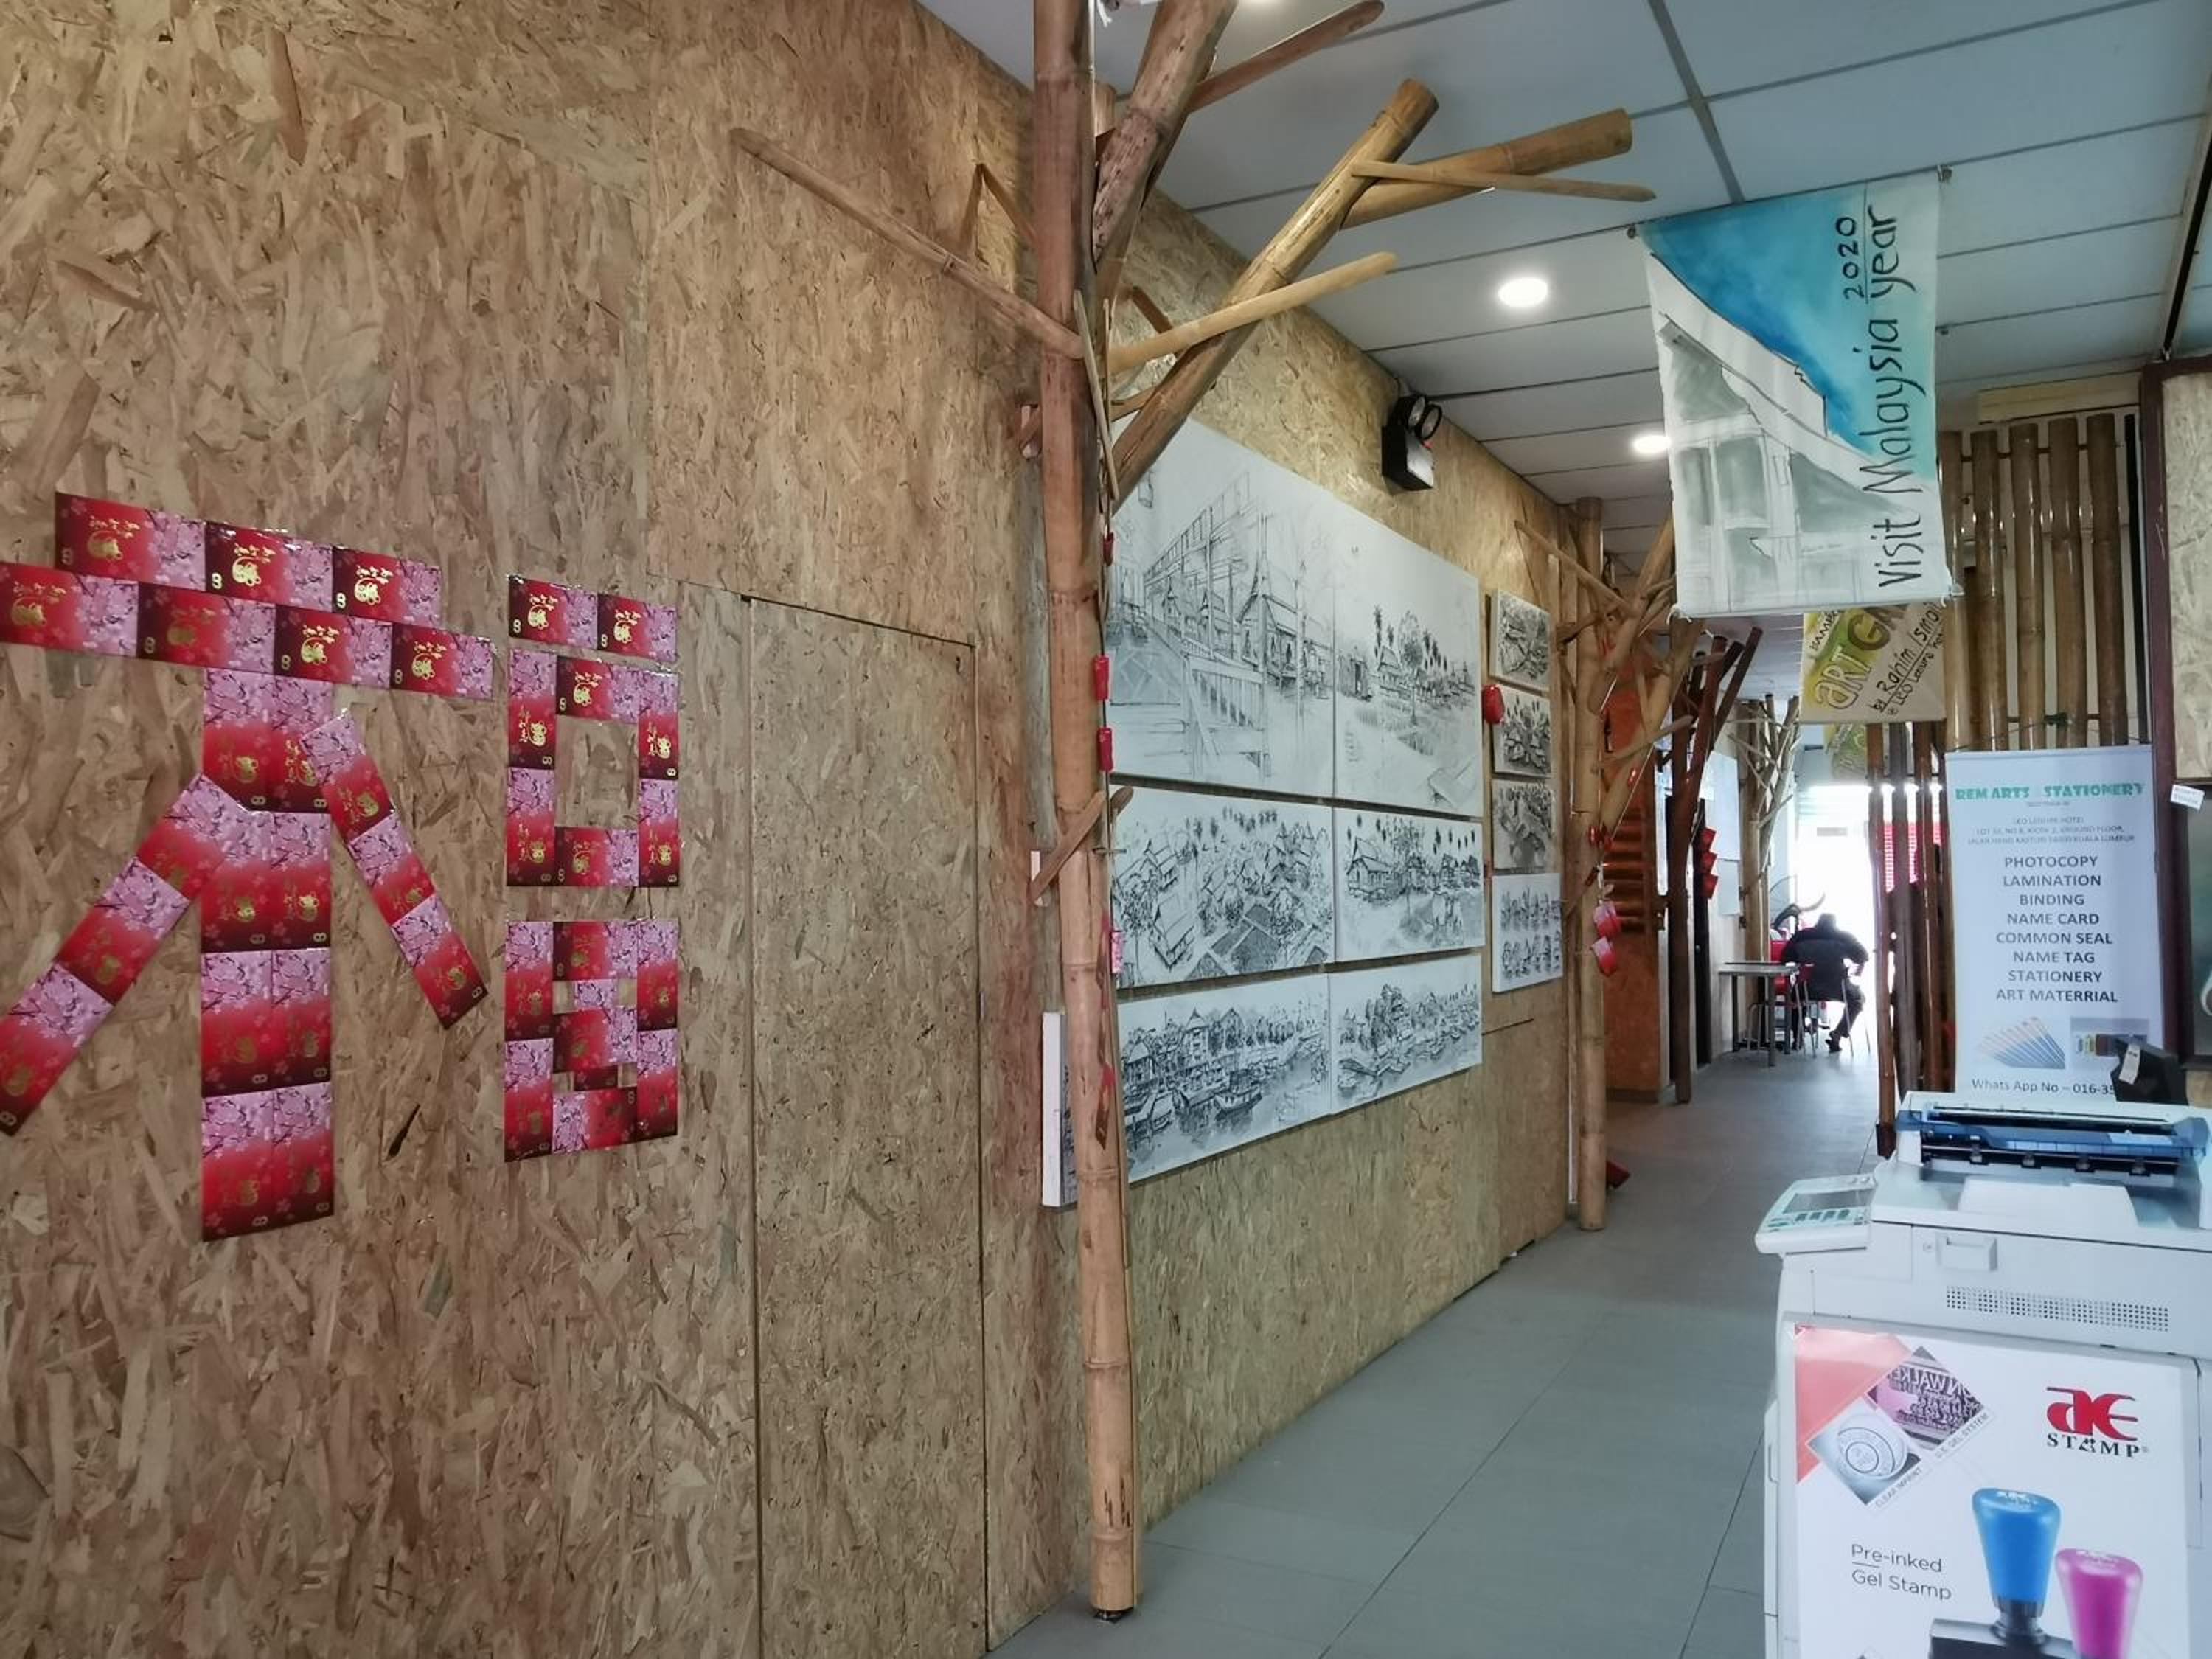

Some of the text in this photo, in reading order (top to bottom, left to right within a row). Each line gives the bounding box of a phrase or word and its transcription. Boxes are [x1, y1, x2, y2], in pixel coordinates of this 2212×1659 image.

[1836, 216, 1864, 299] 2020
[1853, 205, 1926, 588] Visit Malaysia year
[1955, 783, 2144, 800] REM ARTS STATIONERY
[2005, 855, 2098, 868] PHOTOCOPY
[2003, 874, 2101, 887] LAMINATION
[2020, 894, 2084, 906] BINDING
[2007, 913, 2099, 925] NAME CARD
[1996, 932, 2112, 945] COMMON SEAL
[2013, 951, 2095, 964] NAME TAG
[2008, 970, 2102, 983] STATIONERY
[1996, 989, 2118, 1003] ART MATERRIAL
[1972, 1079, 2009, 1091] Whats
[2012, 1081, 2037, 1093] App
[2041, 1082, 2059, 1093] No
[1852, 1543, 1941, 1573] Pre-inked
[1852, 1568, 1952, 1601] Gel Stamp
